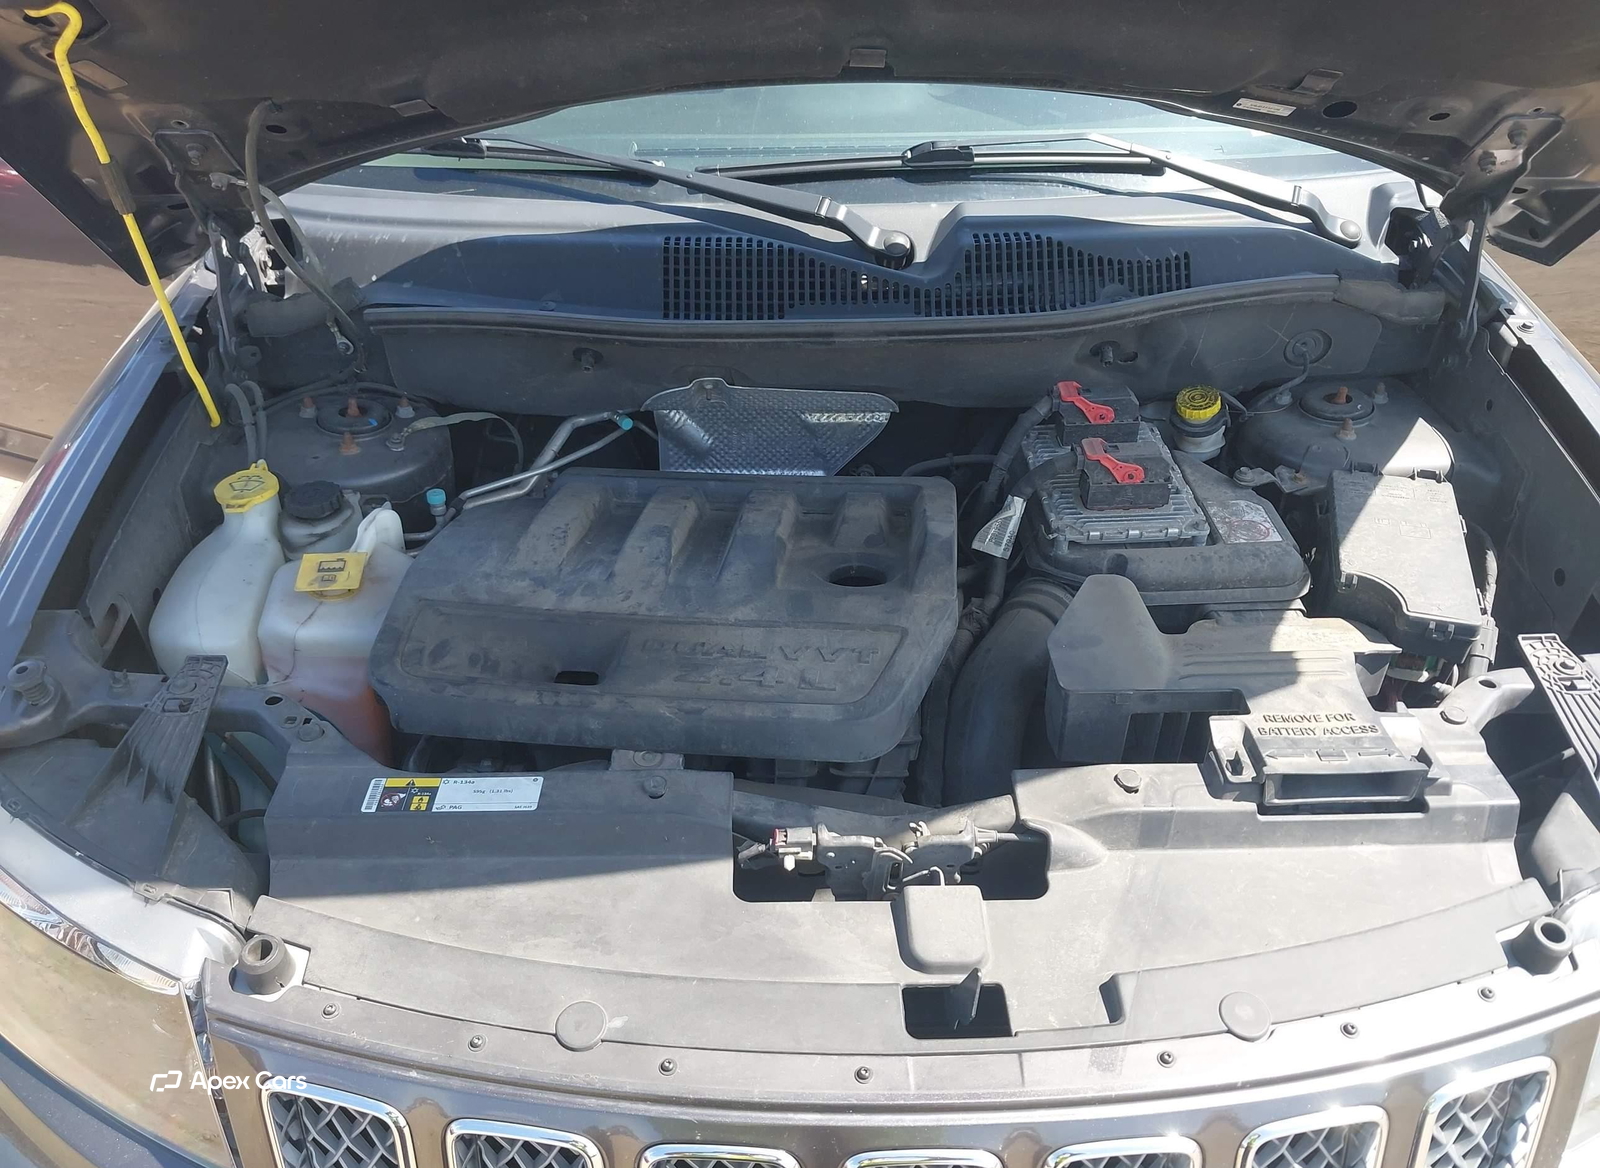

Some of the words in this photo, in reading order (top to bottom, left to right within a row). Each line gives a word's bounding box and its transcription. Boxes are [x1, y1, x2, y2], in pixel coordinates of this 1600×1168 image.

[779, 643, 880, 665] VVT
[1262, 713, 1323, 724] REMOVE
[1325, 712, 1356, 722] FOR
[1258, 726, 1317, 736] BATTERY
[1322, 724, 1379, 735] ACCESS
